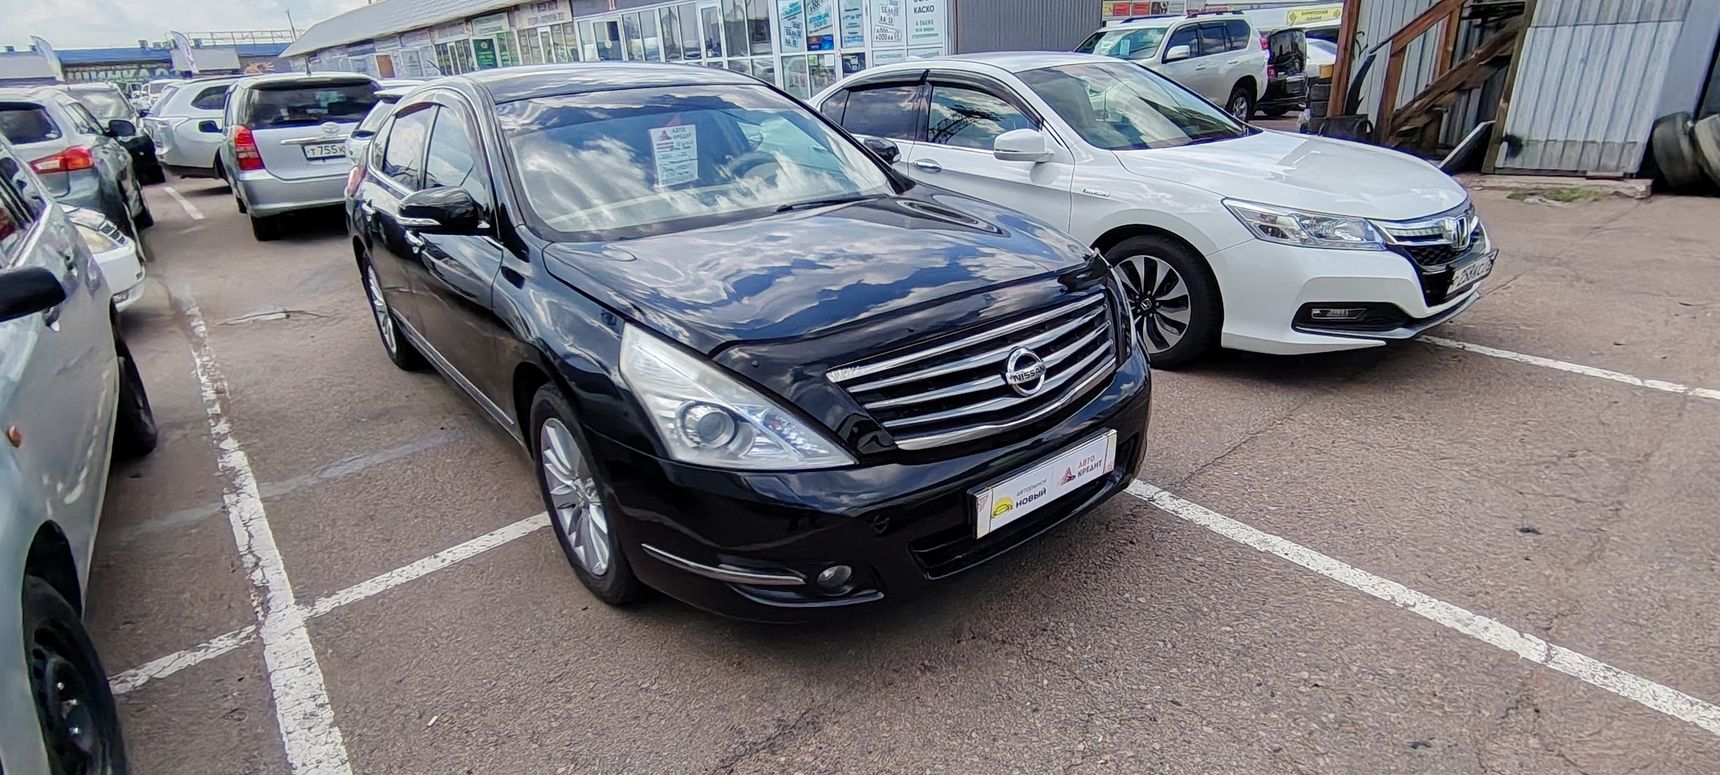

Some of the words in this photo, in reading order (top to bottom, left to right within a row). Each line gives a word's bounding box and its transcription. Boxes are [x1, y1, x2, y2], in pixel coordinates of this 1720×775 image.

[914, 5, 935, 14] КАСКО
[1013, 365, 1045, 382] NISSAN
[1077, 455, 1096, 469] АВТО
[1077, 460, 1103, 477] КРЕДИТ
[1015, 487, 1047, 509] НОВЫЙ
